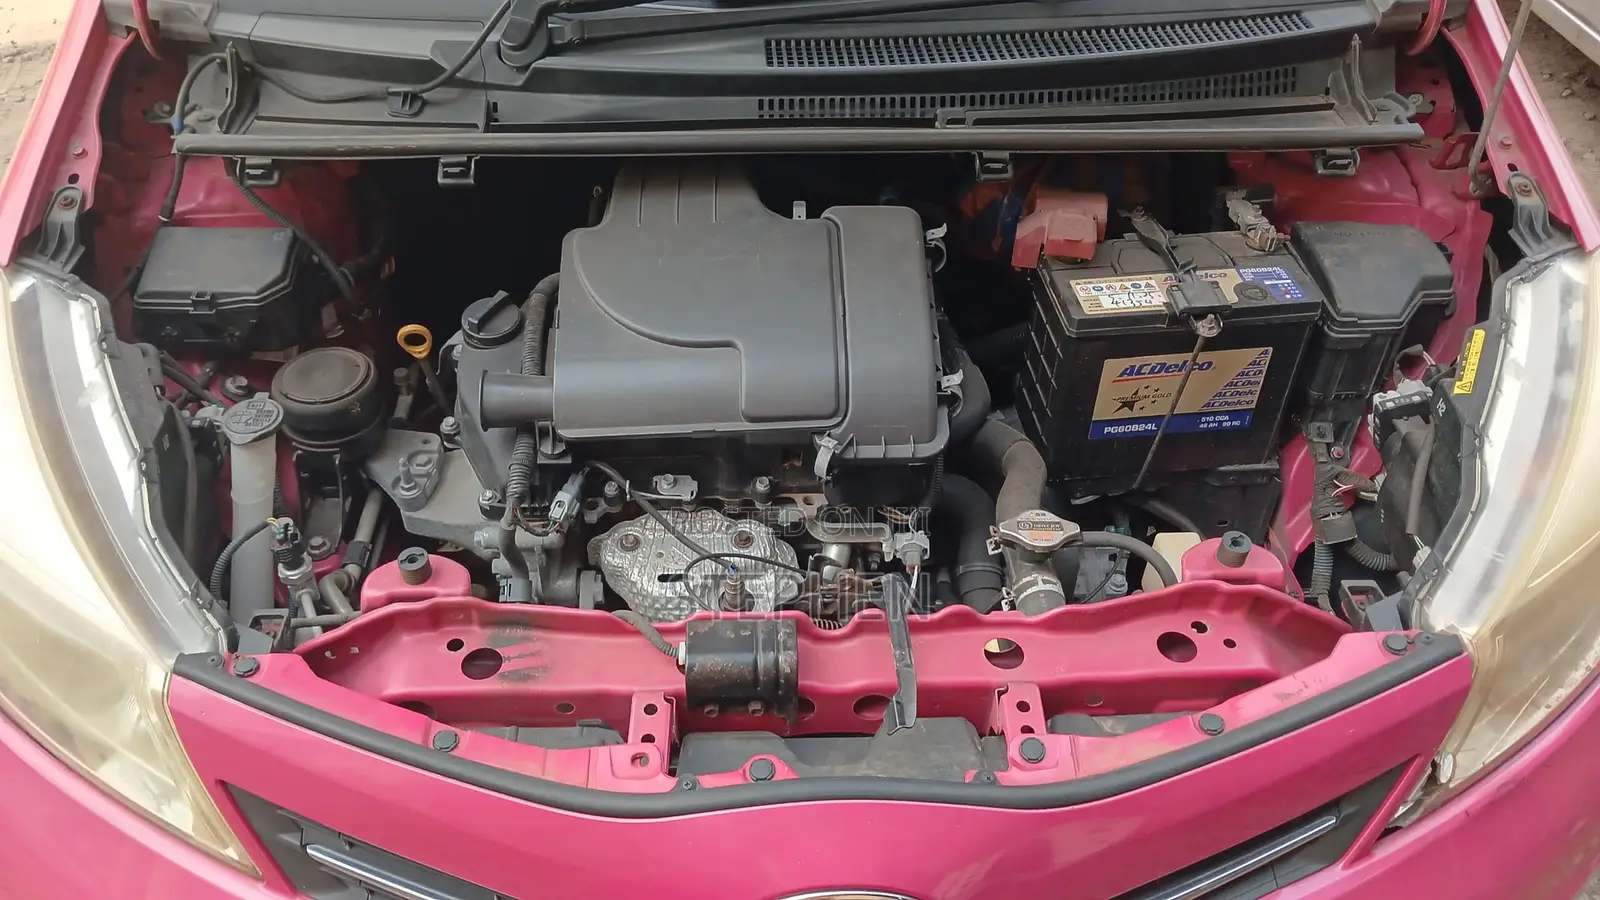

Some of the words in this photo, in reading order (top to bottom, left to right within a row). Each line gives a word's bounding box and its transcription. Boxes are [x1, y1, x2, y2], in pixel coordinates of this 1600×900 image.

[1247, 359, 1266, 367] AC
[1235, 369, 1264, 378] ACD
[1116, 394, 1151, 402] PREMIUM
[1201, 399, 1255, 409] ACDelco
[1103, 422, 1158, 435] PG60B24L
